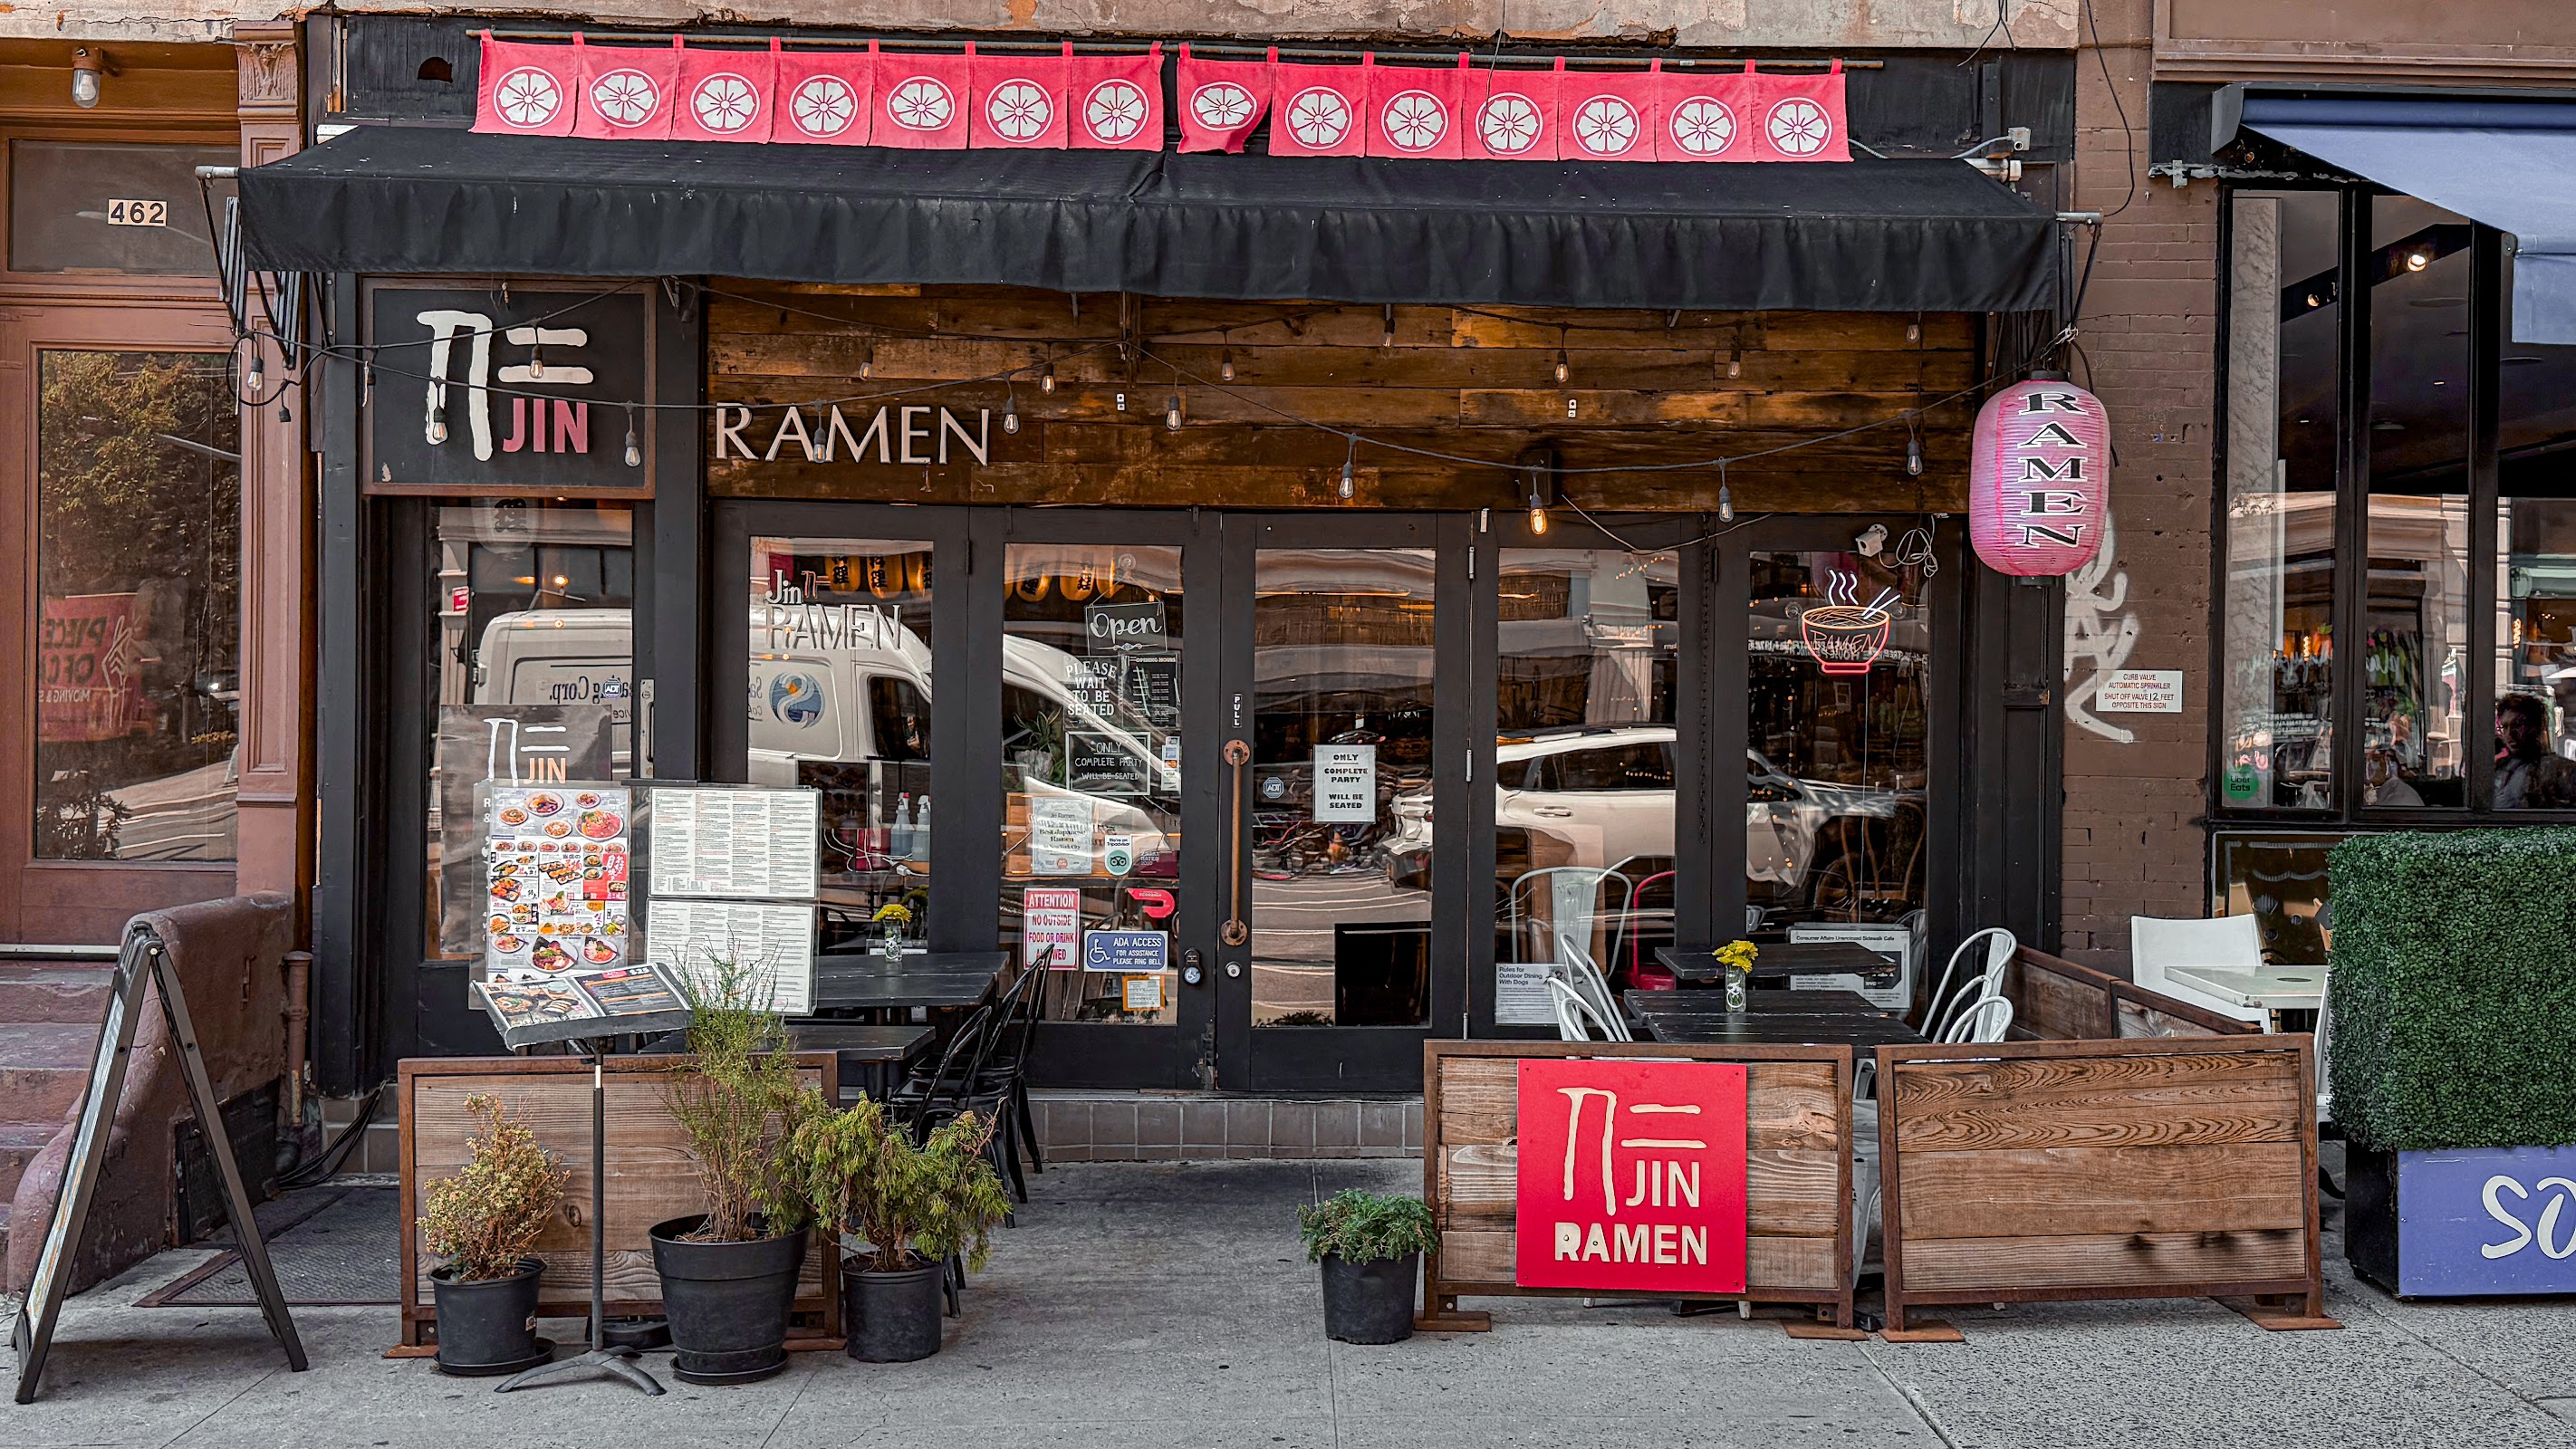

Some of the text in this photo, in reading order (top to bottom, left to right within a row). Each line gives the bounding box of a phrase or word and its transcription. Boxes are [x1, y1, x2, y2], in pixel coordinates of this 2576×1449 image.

[111, 202, 165, 224] 462
[502, 398, 588, 454] JIN
[716, 402, 990, 466] RAMEN
[2014, 391, 2089, 549] RAMEN
[765, 569, 802, 605] Jin
[766, 603, 902, 650] RAMEN
[1090, 613, 1162, 645] Open
[1810, 628, 1882, 656] RAMEN
[1065, 661, 1117, 678] PLEASE
[1075, 677, 1107, 688] WAIT
[604, 685, 620, 695] ADT
[1072, 689, 1110, 702] TO BE
[2149, 693, 2158, 701] 12
[1068, 704, 1114, 715] SEATED
[1096, 742, 1122, 753] ONLY
[1074, 757, 1142, 767] COMPLETE PARTY
[523, 757, 566, 784] JIN
[1114, 772, 1139, 780] SEATED
[1267, 783, 1281, 792] ADT
[1029, 894, 1074, 907] ATTENTION
[1032, 915, 1072, 926] NO OUTSIDE
[1029, 933, 1074, 943] FOOD OR DRINK
[1113, 938, 1162, 946] ADA ACCESS
[1626, 1160, 1699, 1207] JIN
[1555, 1222, 1707, 1265] RAMEN
